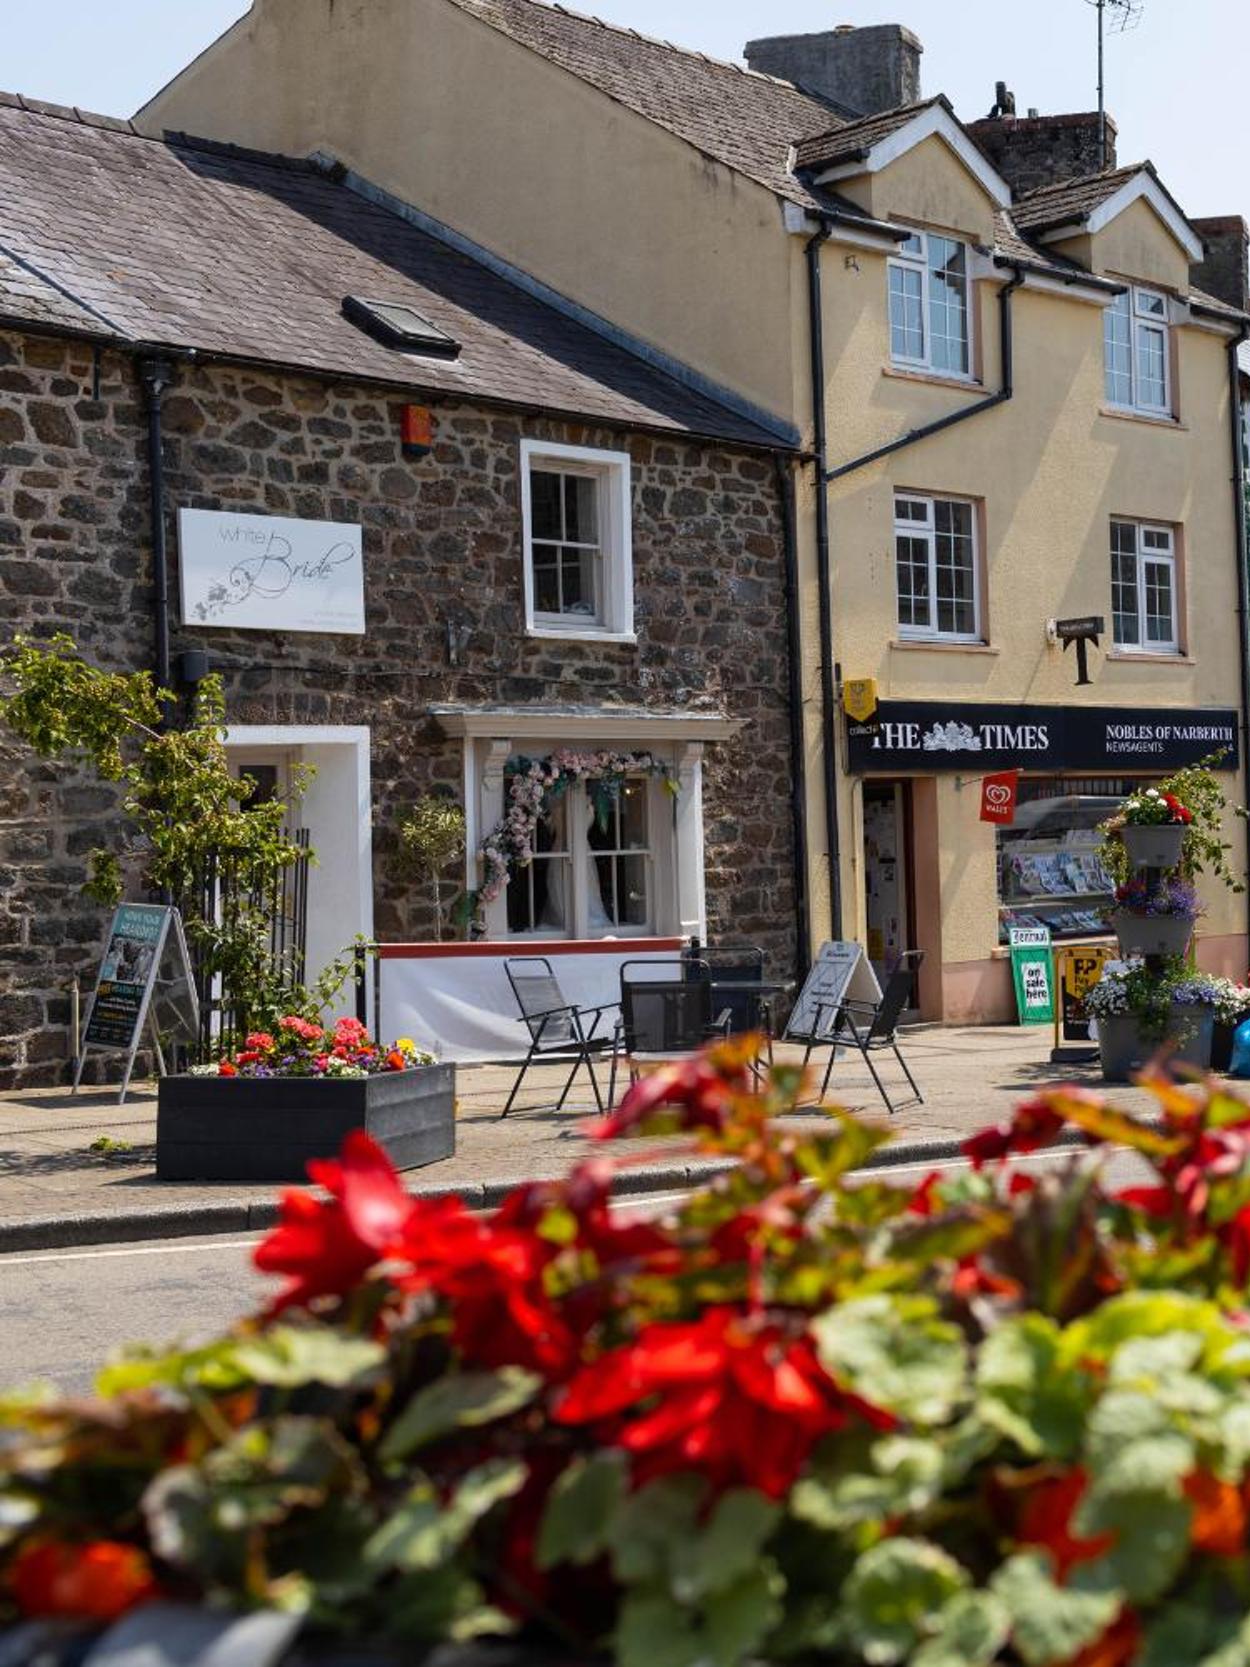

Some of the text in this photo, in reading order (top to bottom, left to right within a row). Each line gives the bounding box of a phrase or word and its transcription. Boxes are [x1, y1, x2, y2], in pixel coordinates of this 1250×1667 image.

[230, 532, 356, 599] Bride
[979, 725, 1050, 750] TIMES
[1106, 725, 1233, 740] NOBLES OF NARBERTH
[1106, 741, 1165, 752] NEWSAGENTS
[1028, 969, 1040, 977] on
[1026, 978, 1045, 988] sale
[1026, 989, 1047, 999] here
